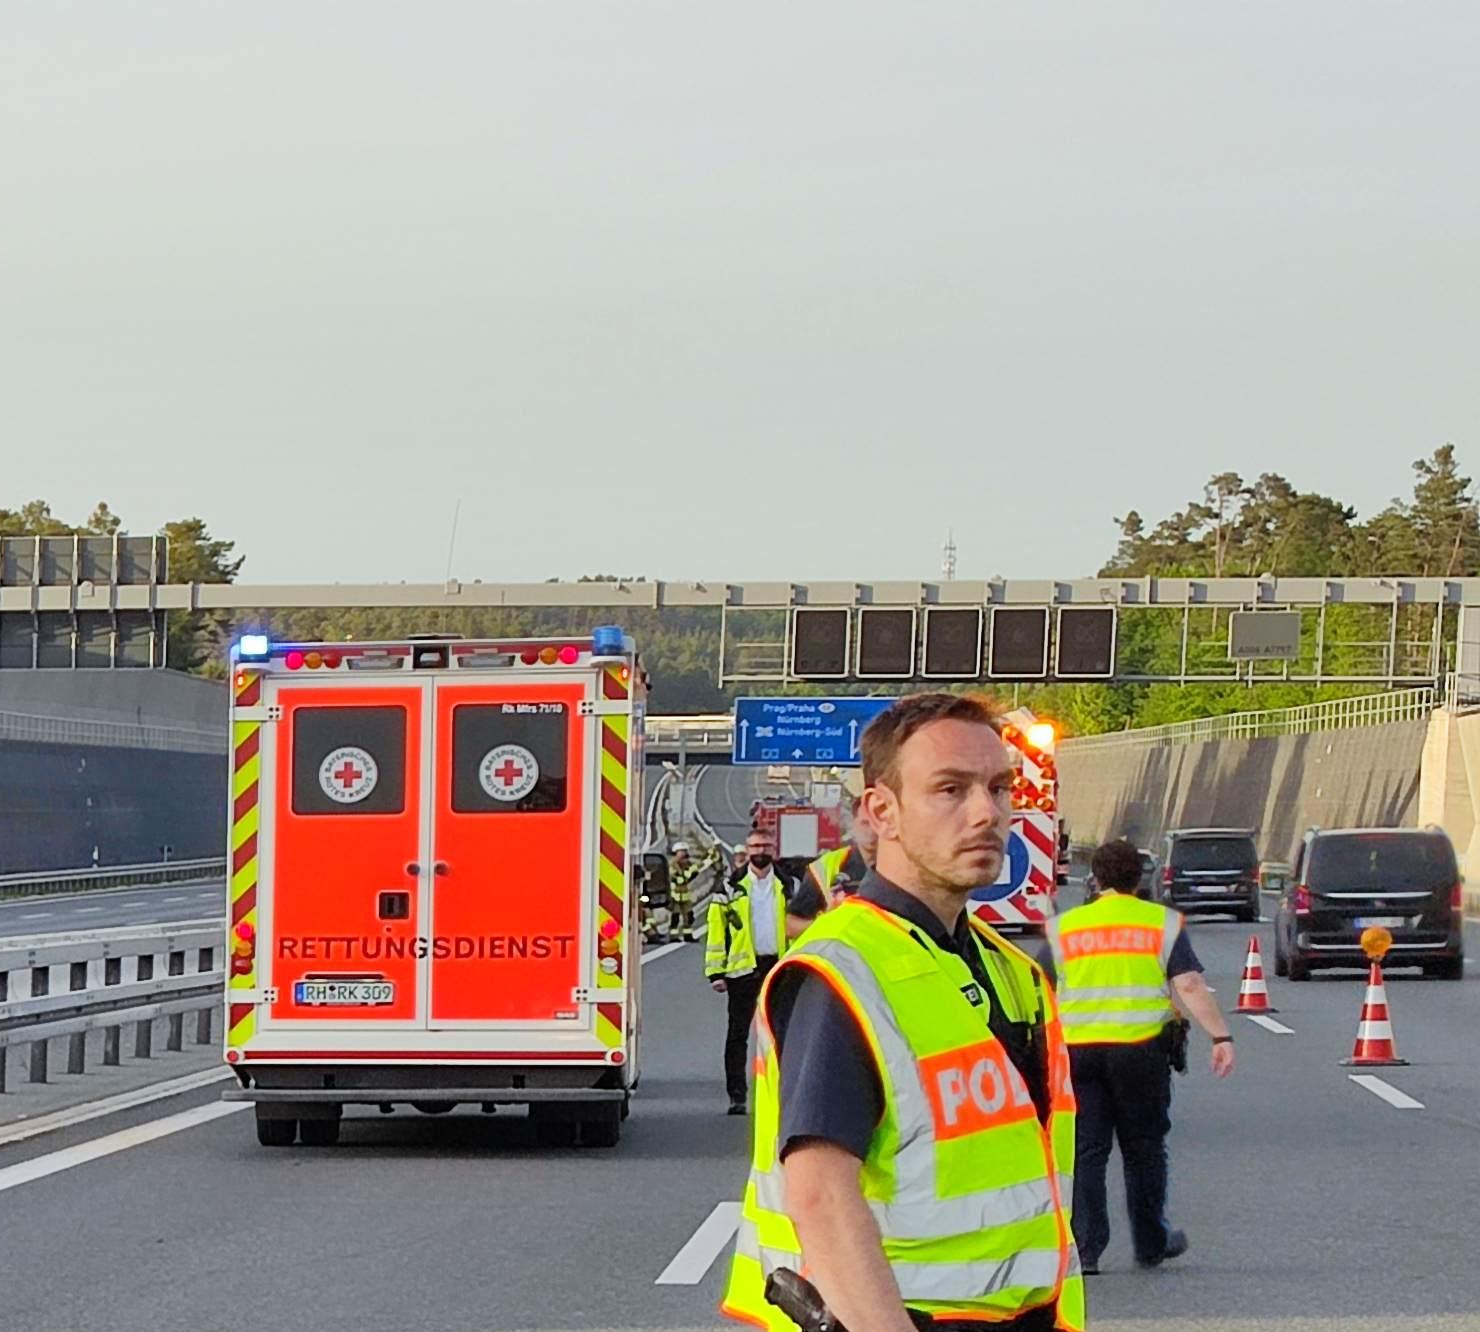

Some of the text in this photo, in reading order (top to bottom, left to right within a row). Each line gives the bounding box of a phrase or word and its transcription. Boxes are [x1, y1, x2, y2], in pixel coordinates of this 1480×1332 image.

[278, 935, 575, 959] RETTUNGSDIENST
[1067, 929, 1155, 954] POLIZEI
[306, 985, 392, 1000] RH RK 309
